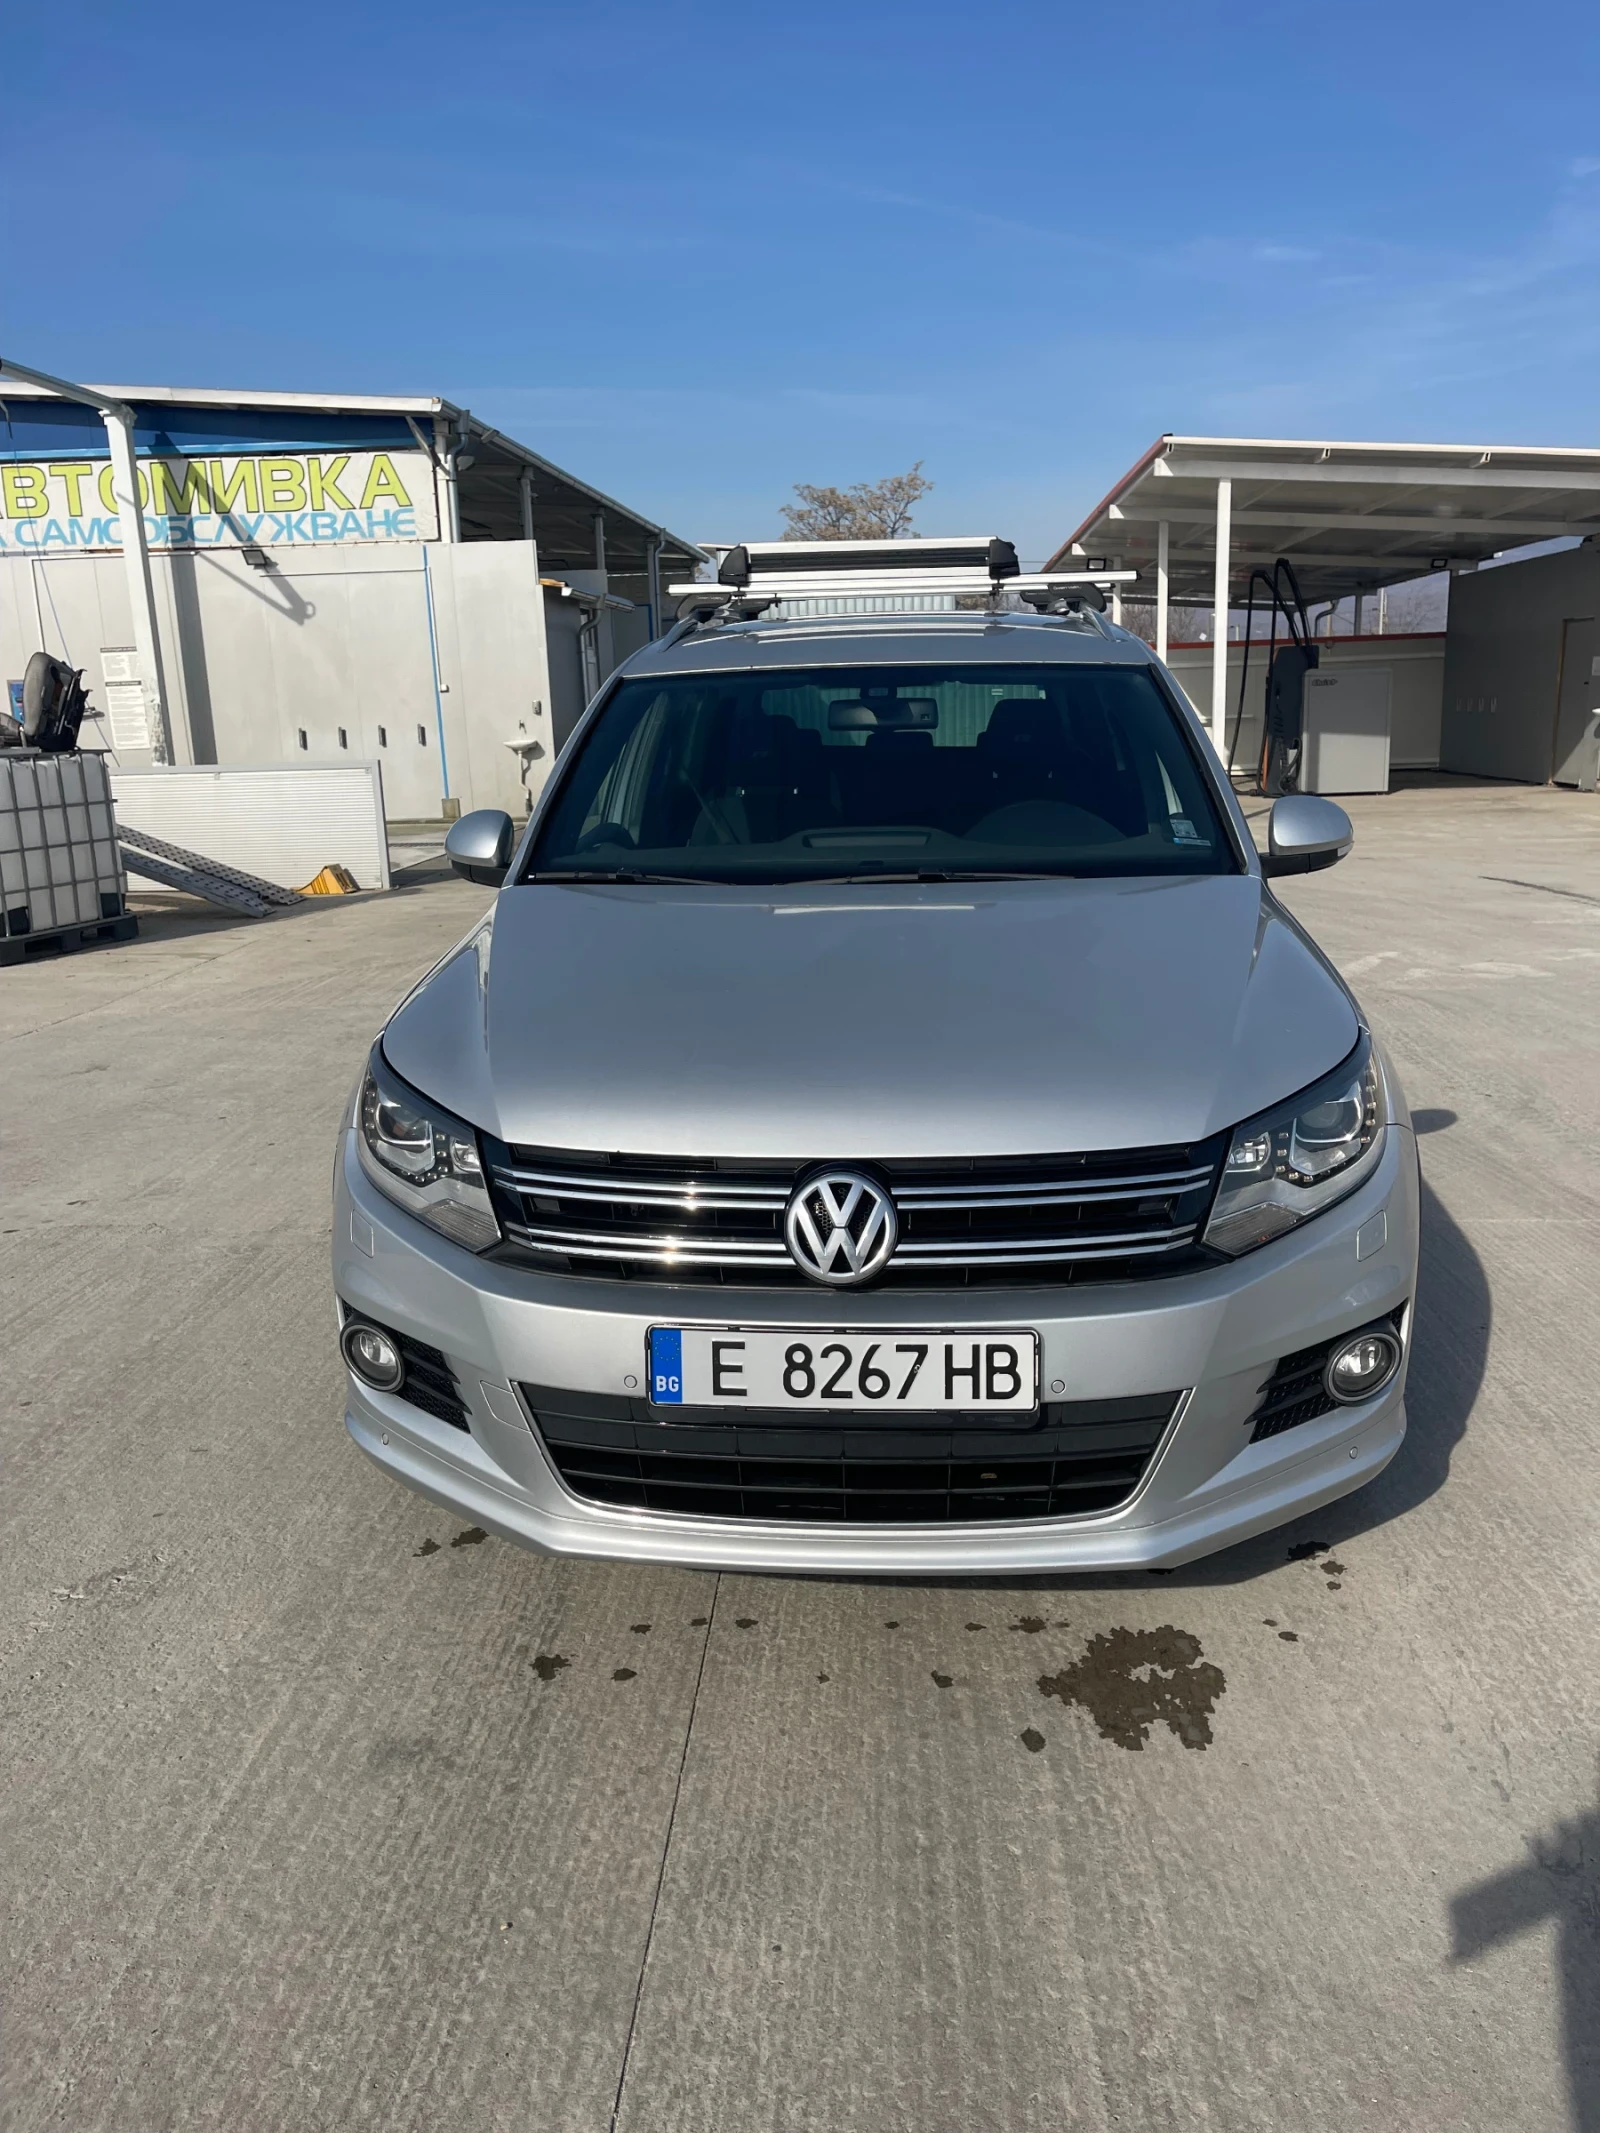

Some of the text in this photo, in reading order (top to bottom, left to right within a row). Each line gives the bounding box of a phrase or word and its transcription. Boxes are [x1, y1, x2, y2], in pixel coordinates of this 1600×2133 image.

[0, 454, 412, 519] ВТОМИВКА
[656, 1375, 679, 1392] BG
[712, 1340, 1022, 1400] E 8267 HB
